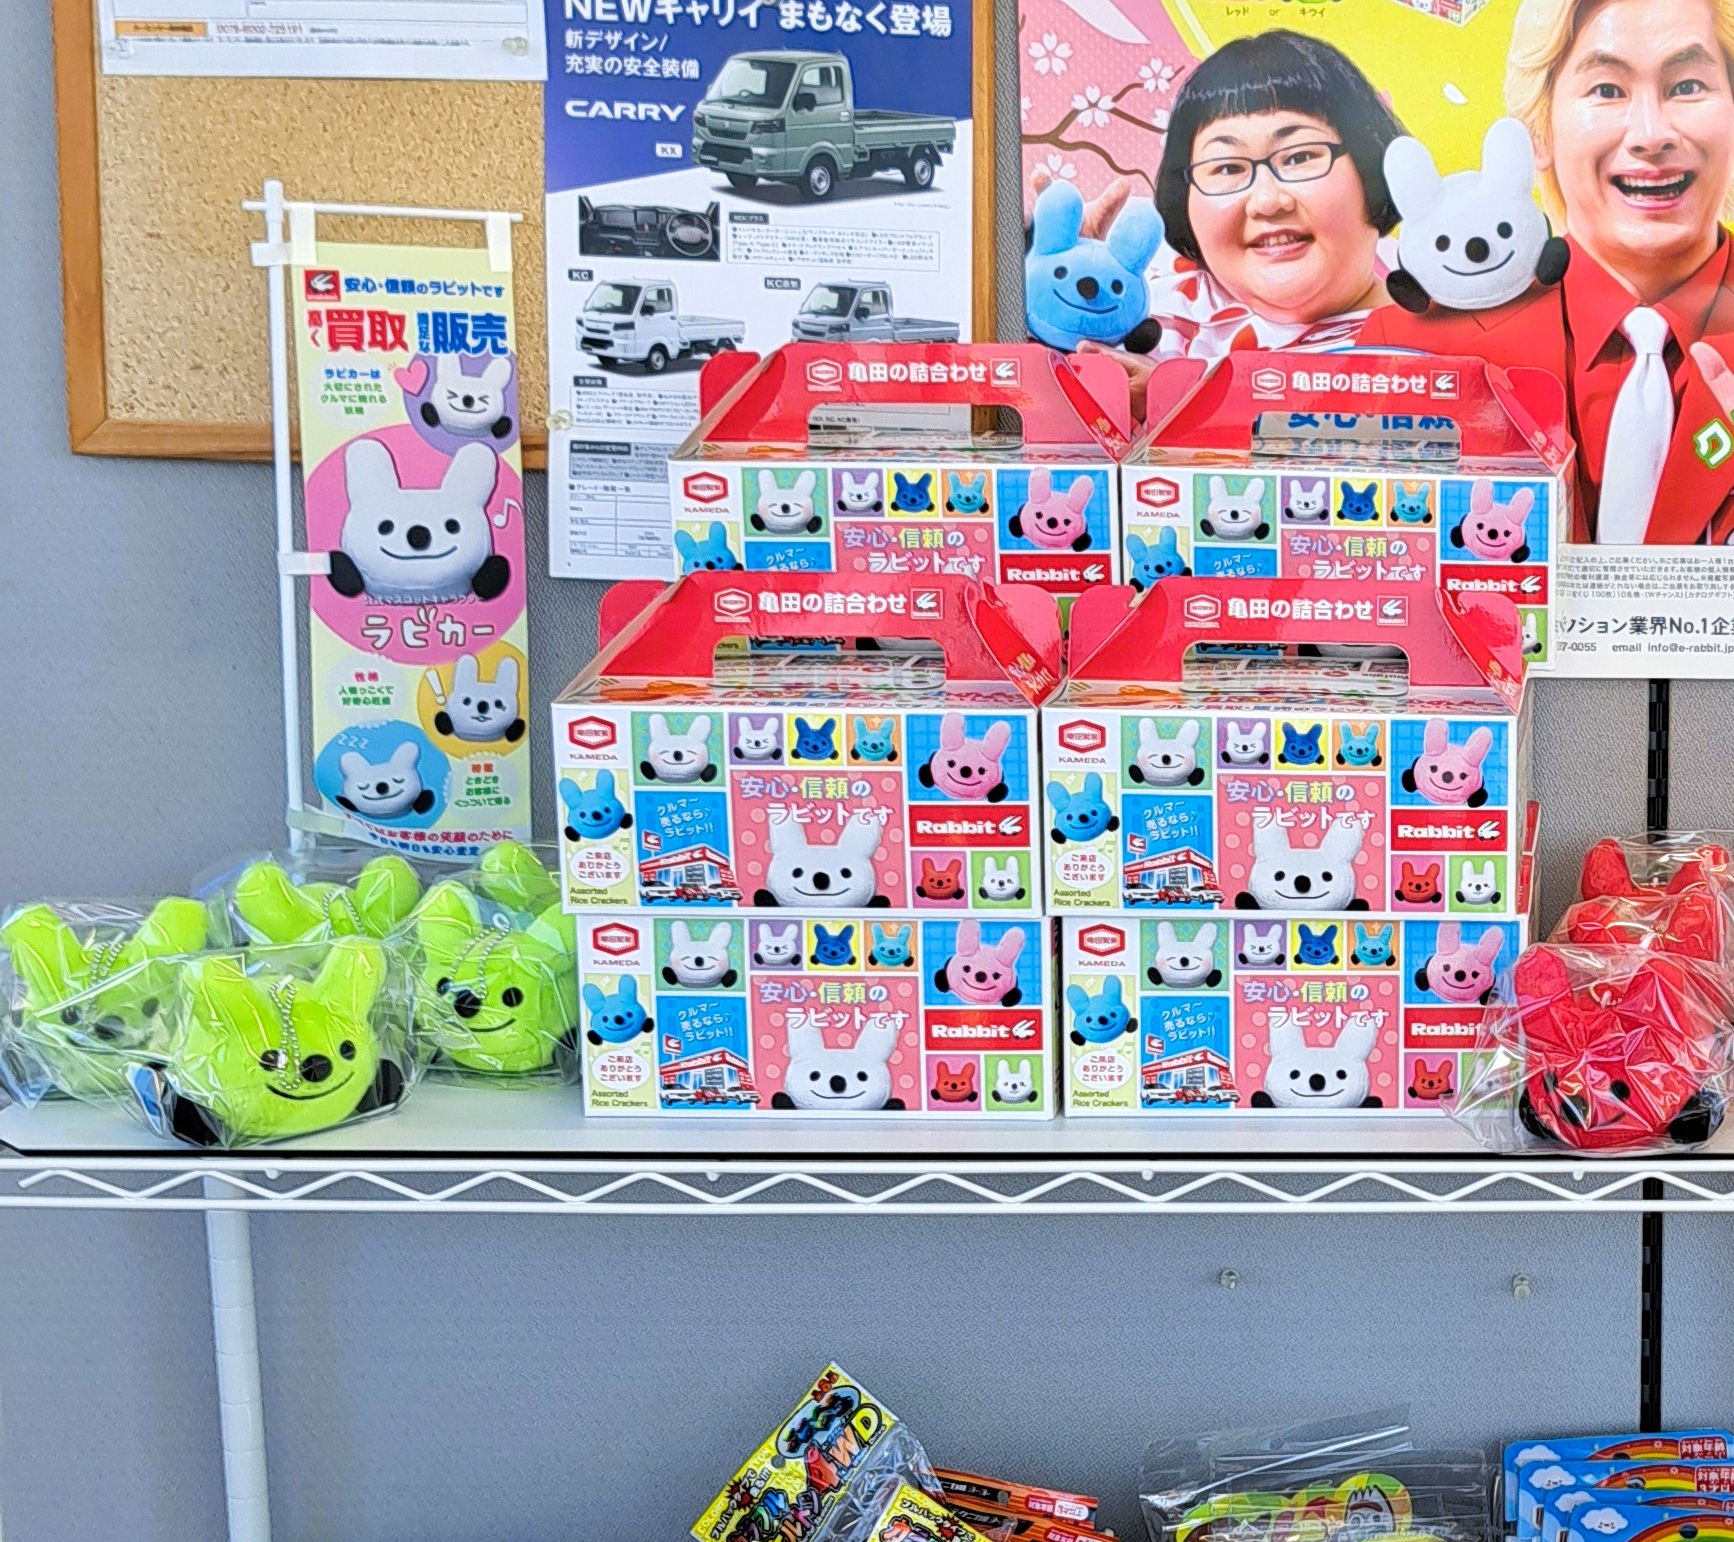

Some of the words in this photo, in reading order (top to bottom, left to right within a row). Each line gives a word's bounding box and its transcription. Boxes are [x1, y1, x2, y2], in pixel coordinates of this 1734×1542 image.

[779, 3, 952, 36] まもなく登場
[565, 55, 699, 79] 充実の安全装備
[565, 101, 685, 122] CARRY
[573, 271, 589, 279] KC
[326, 310, 408, 352] 買取
[432, 312, 508, 355] 販売
[1292, 373, 1426, 394] 亀田の詰合わせ
[759, 593, 907, 614] 亀田の詰合わせ
[1227, 598, 1372, 620] 亀田の詰合わせ
[362, 606, 494, 649] ラビカー
[1648, 643, 1734, 655] info@e-rabbit.jp
[786, 1009, 908, 1029] ラビットです
[1268, 1007, 1389, 1028] ラビットです
